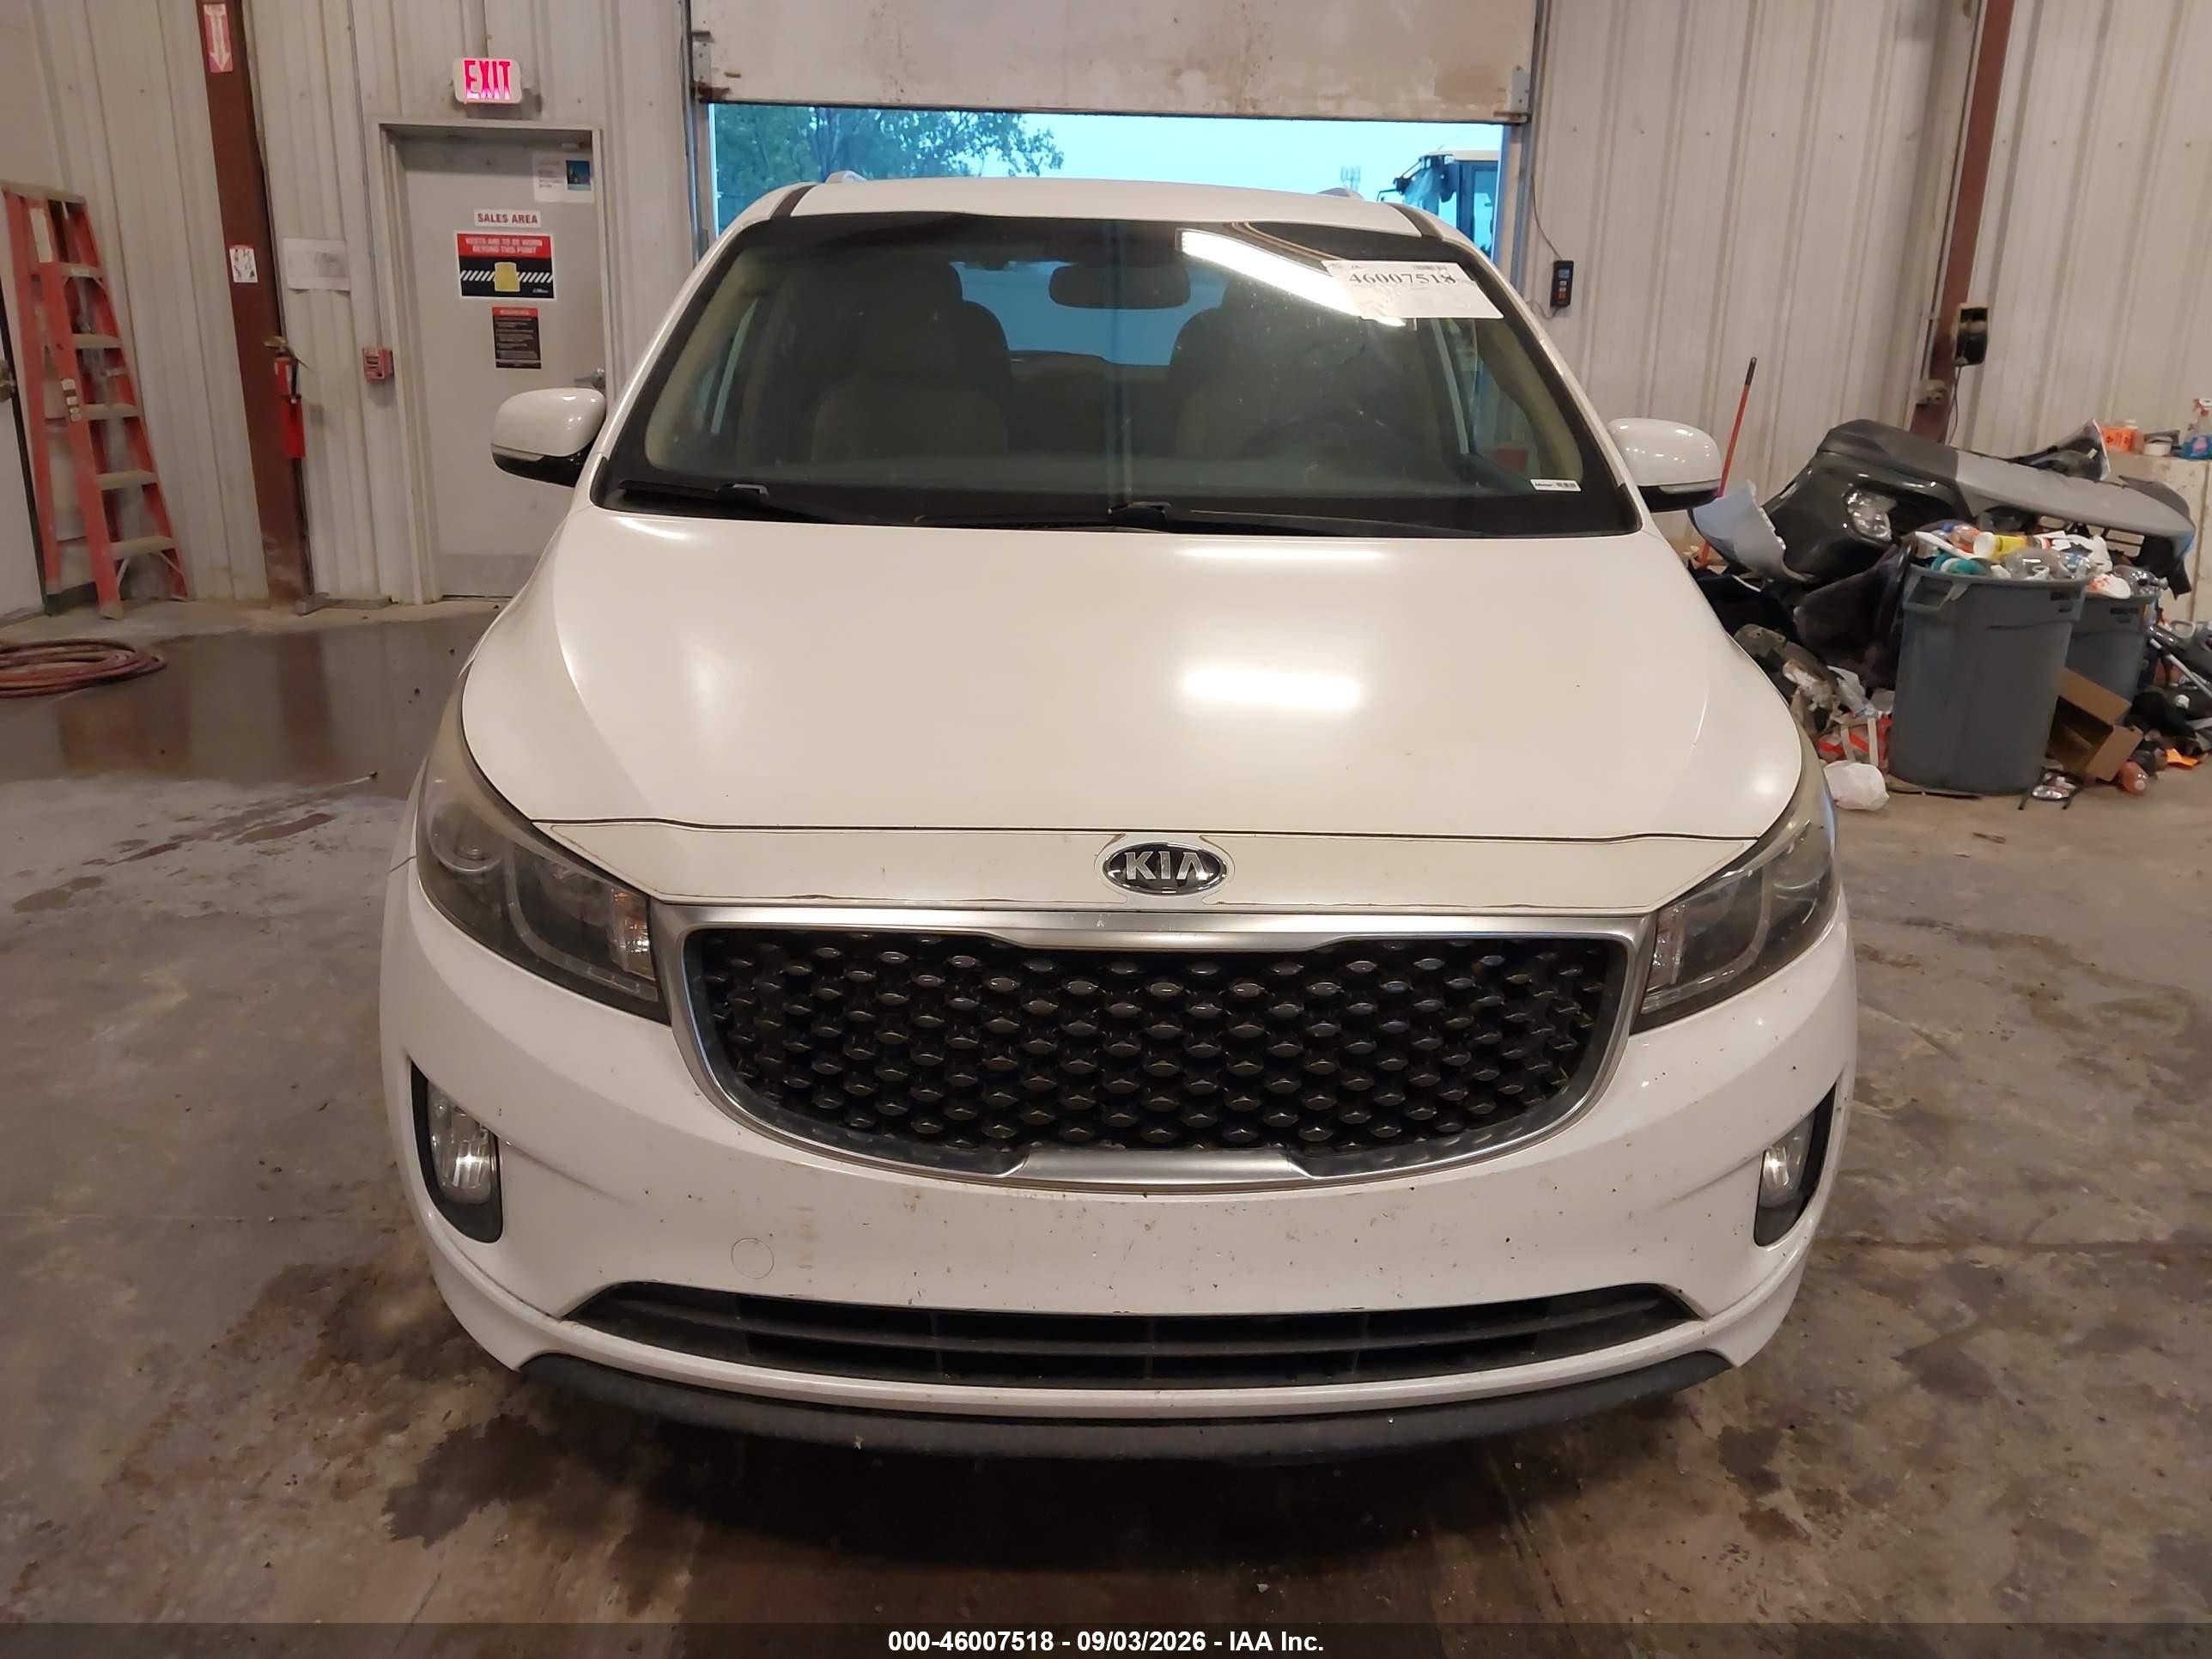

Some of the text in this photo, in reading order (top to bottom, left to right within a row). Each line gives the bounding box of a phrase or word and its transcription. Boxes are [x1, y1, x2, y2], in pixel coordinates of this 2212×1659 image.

[465, 60, 510, 100] EXIT
[477, 213, 538, 223] SALES AREA
[1349, 273, 1456, 283] 46007518
[1124, 851, 1209, 880] KIA
